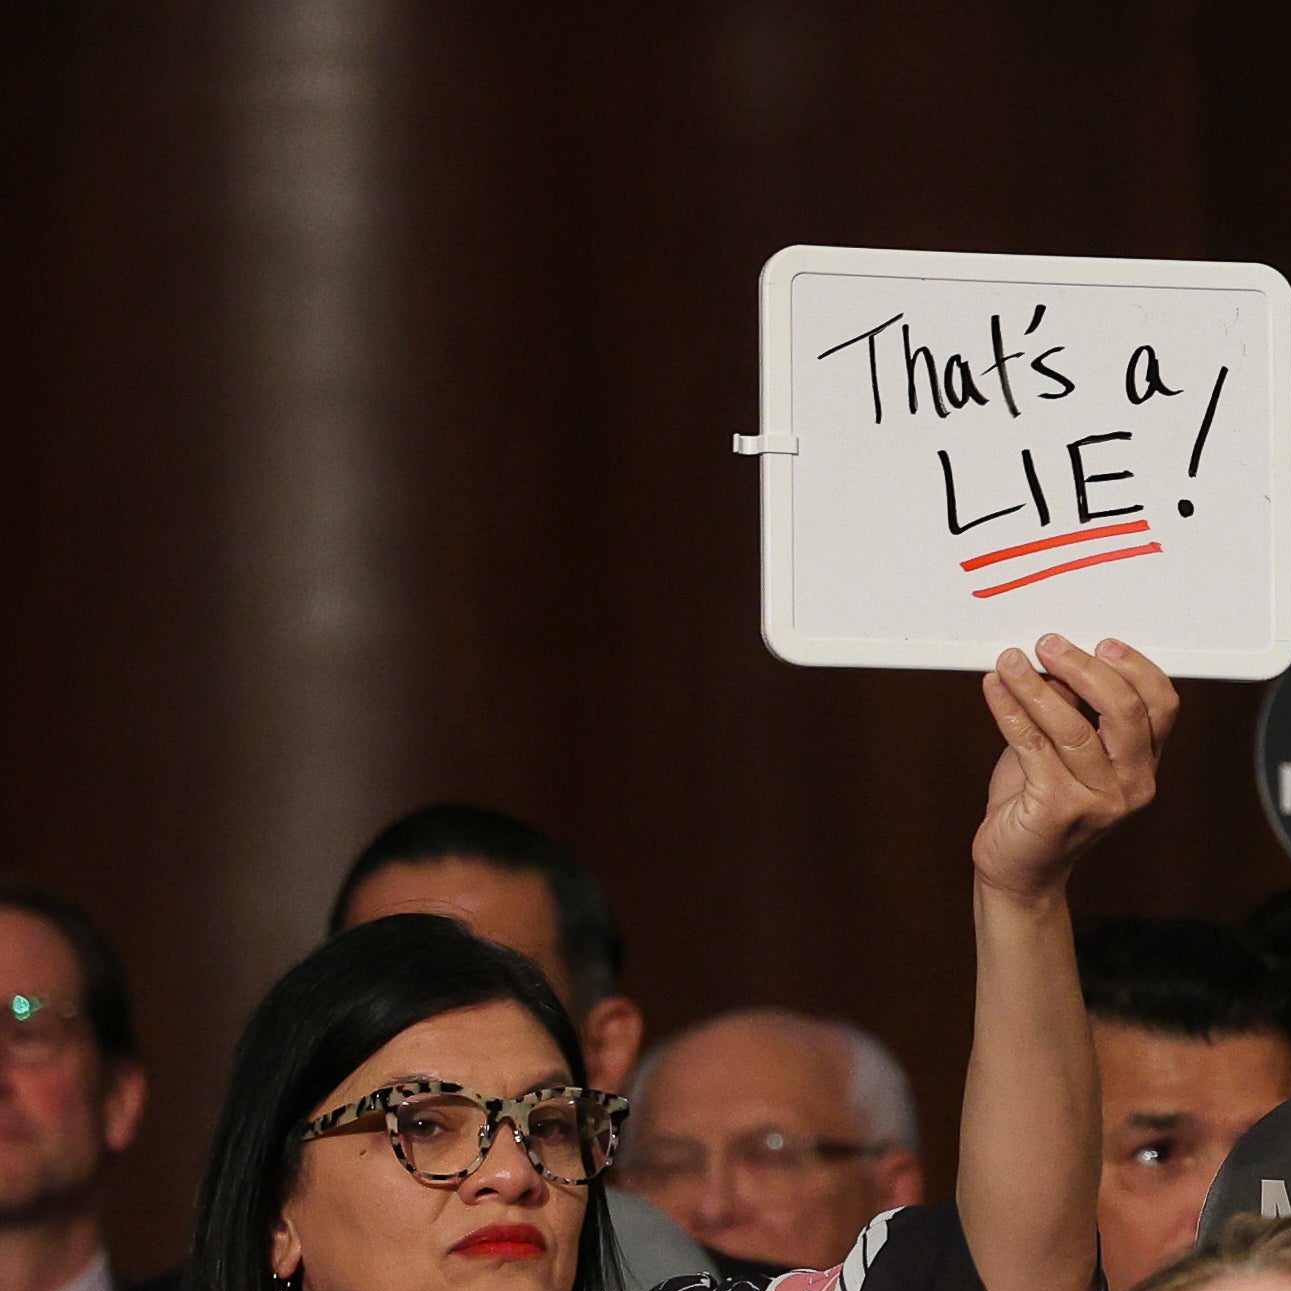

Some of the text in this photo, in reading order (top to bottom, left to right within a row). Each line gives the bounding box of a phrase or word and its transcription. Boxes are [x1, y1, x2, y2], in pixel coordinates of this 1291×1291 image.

[817, 304, 1184, 425] That's a
[938, 365, 1229, 536] LIE!
